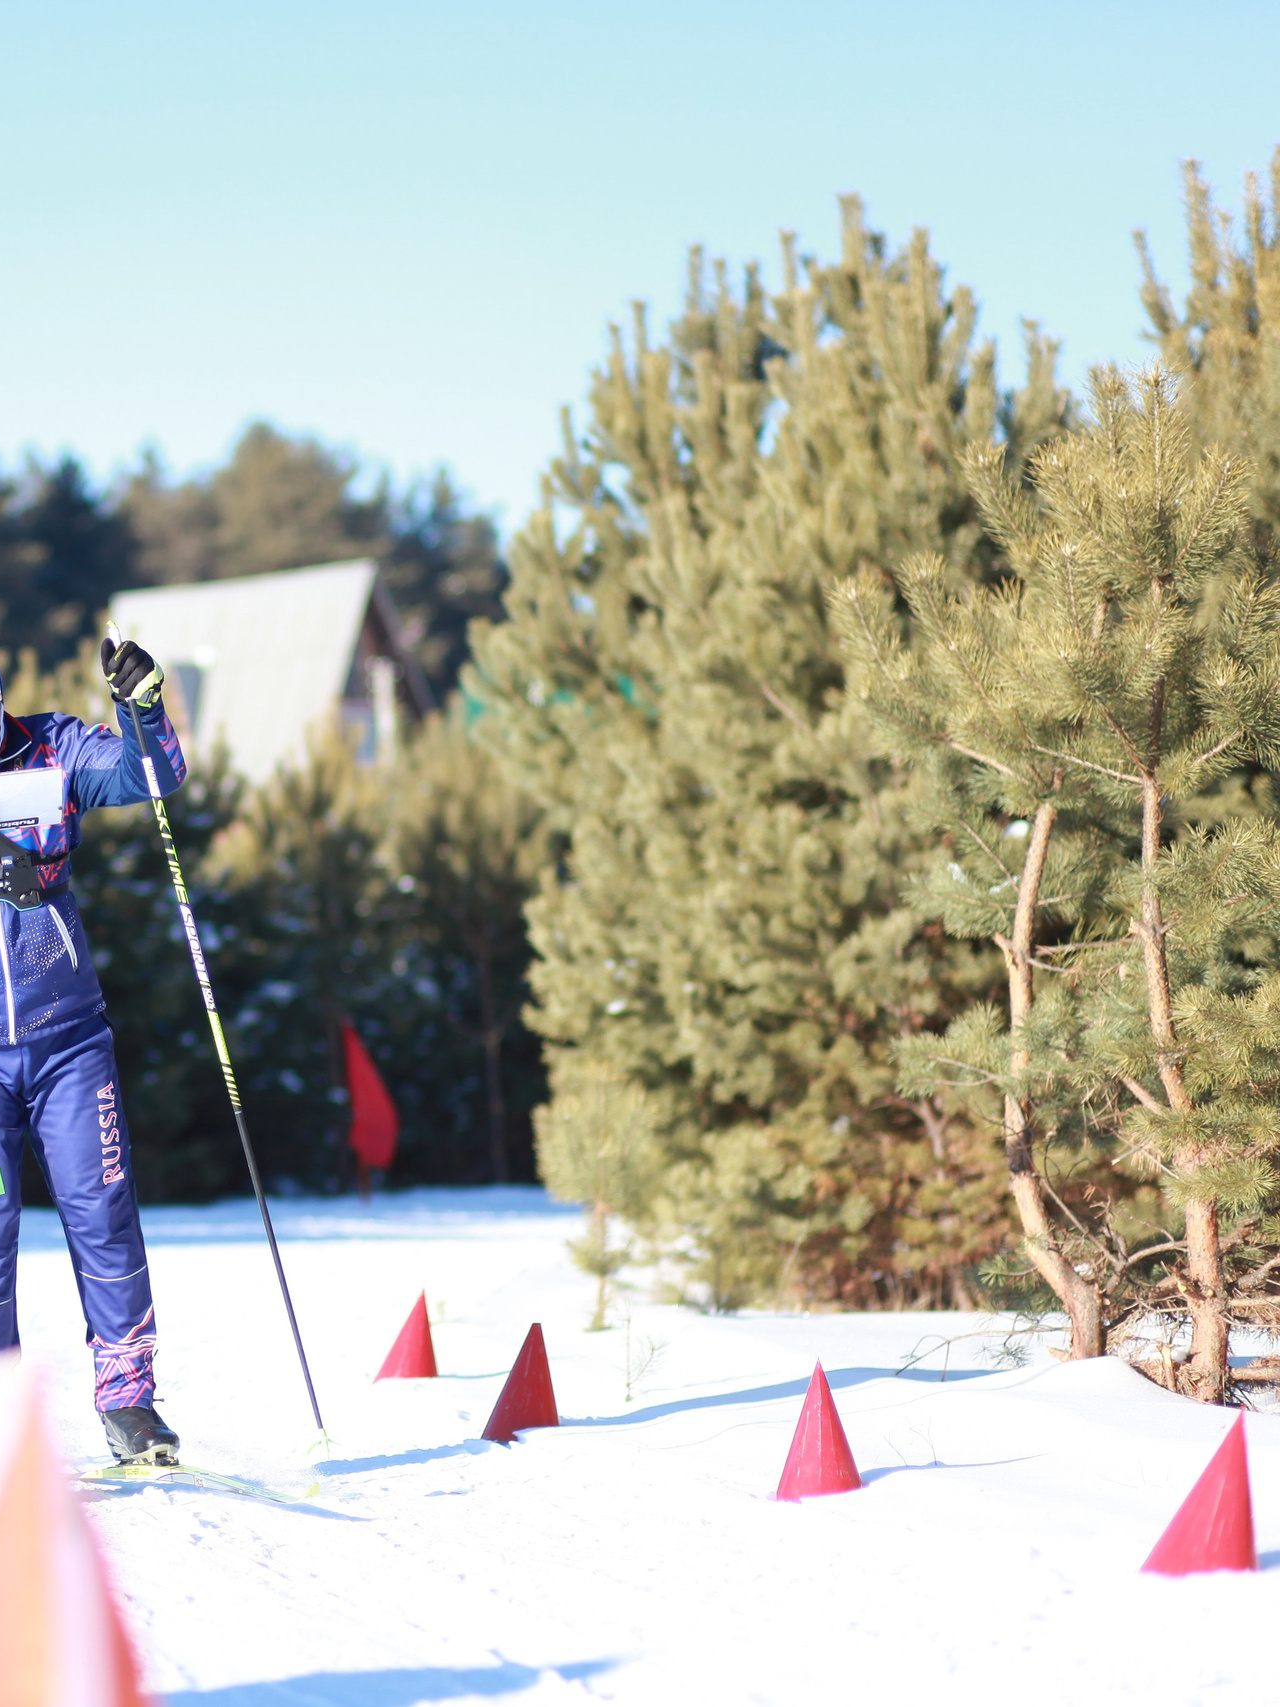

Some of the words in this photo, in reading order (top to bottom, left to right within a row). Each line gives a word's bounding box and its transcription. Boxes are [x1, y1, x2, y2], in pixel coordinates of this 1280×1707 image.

[151, 798, 172, 839] SKI
[164, 843, 190, 905] TIME
[184, 912, 209, 981] SPORT
[97, 1080, 125, 1186] RUSSIA
